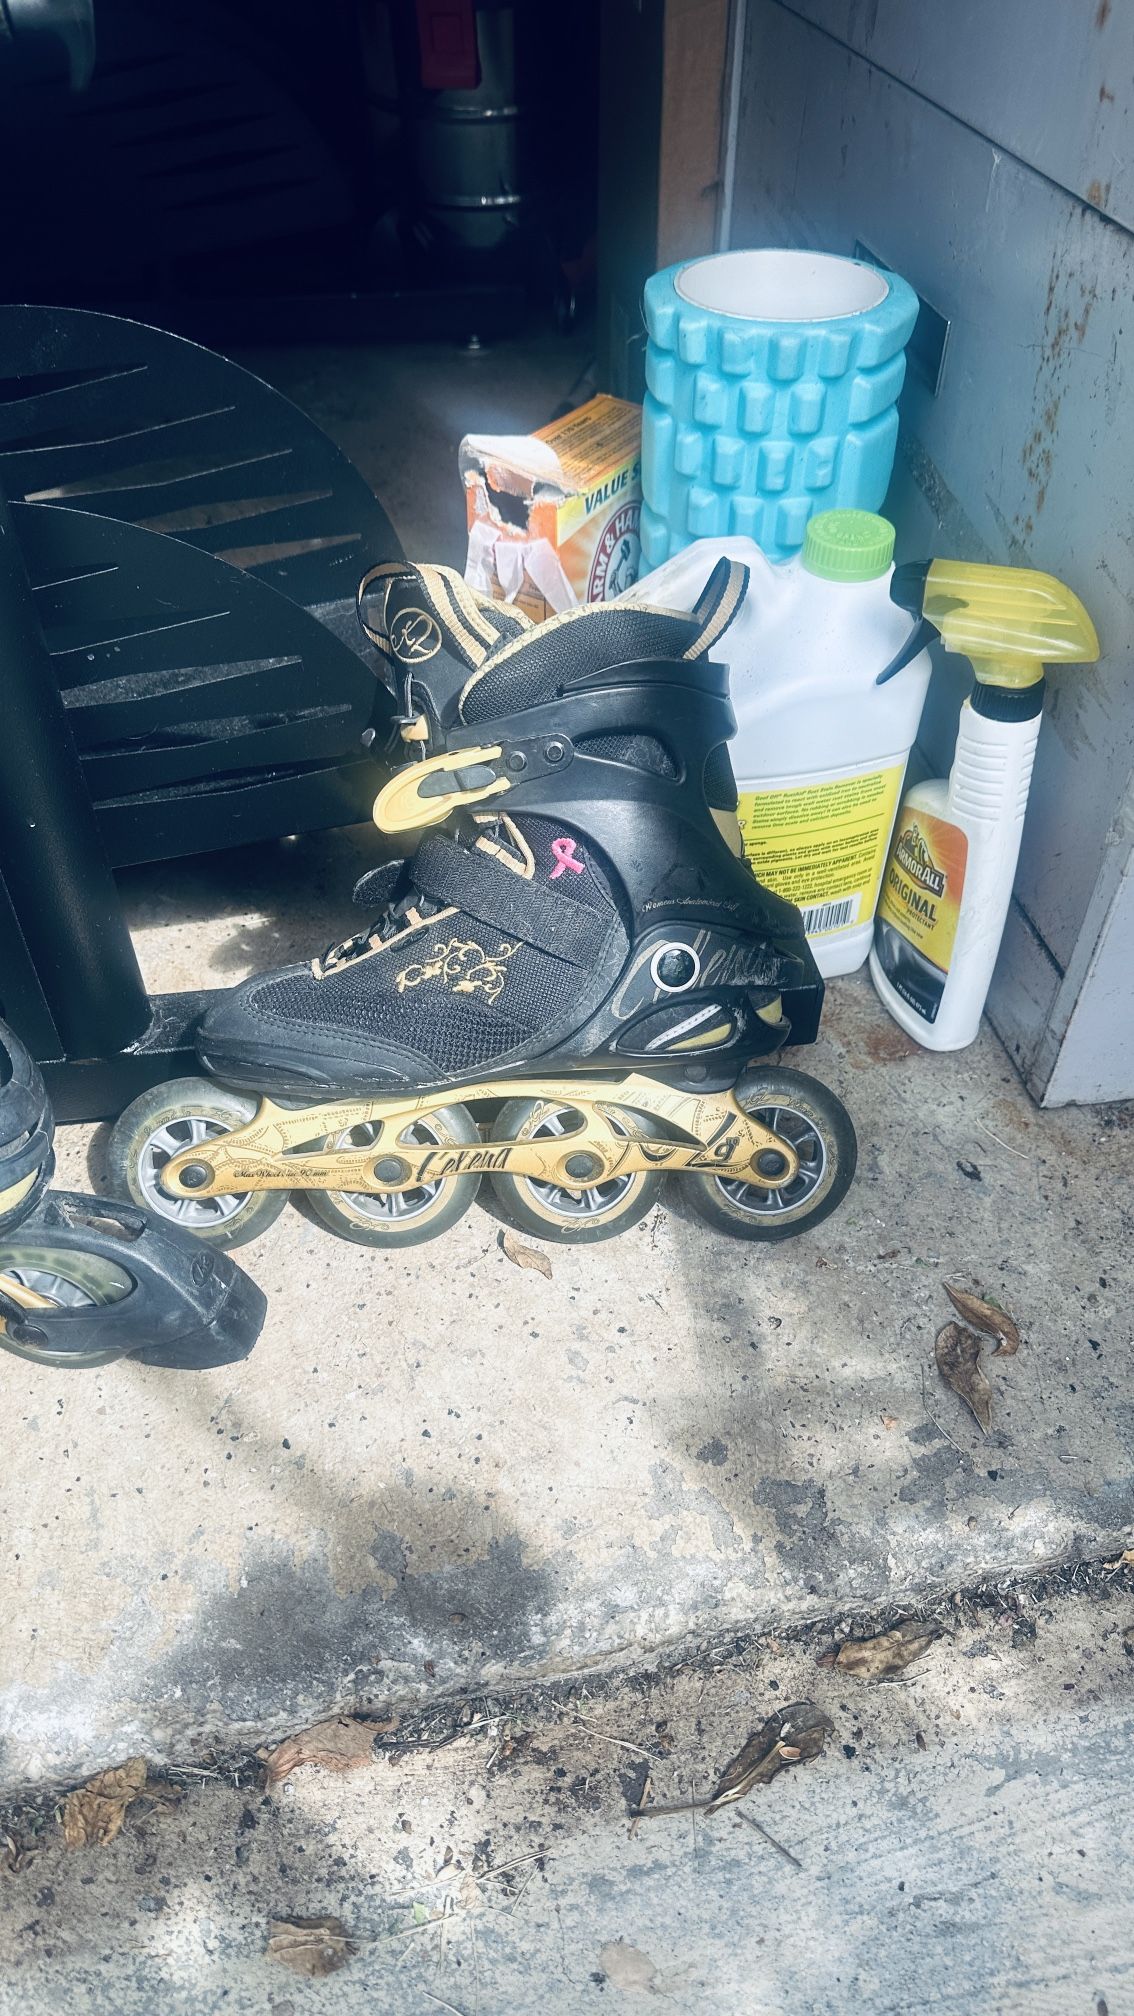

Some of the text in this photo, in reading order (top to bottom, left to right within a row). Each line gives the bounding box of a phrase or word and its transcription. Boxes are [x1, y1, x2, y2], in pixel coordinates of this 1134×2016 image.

[585, 469, 628, 515] VALUE
[604, 533, 616, 554] &
[798, 860, 832, 872] IMMEDIATELY
[889, 867, 936, 922] ORIGINAL
[906, 908, 935, 931] PROTECTANT
[232, 1170, 255, 1178] Max
